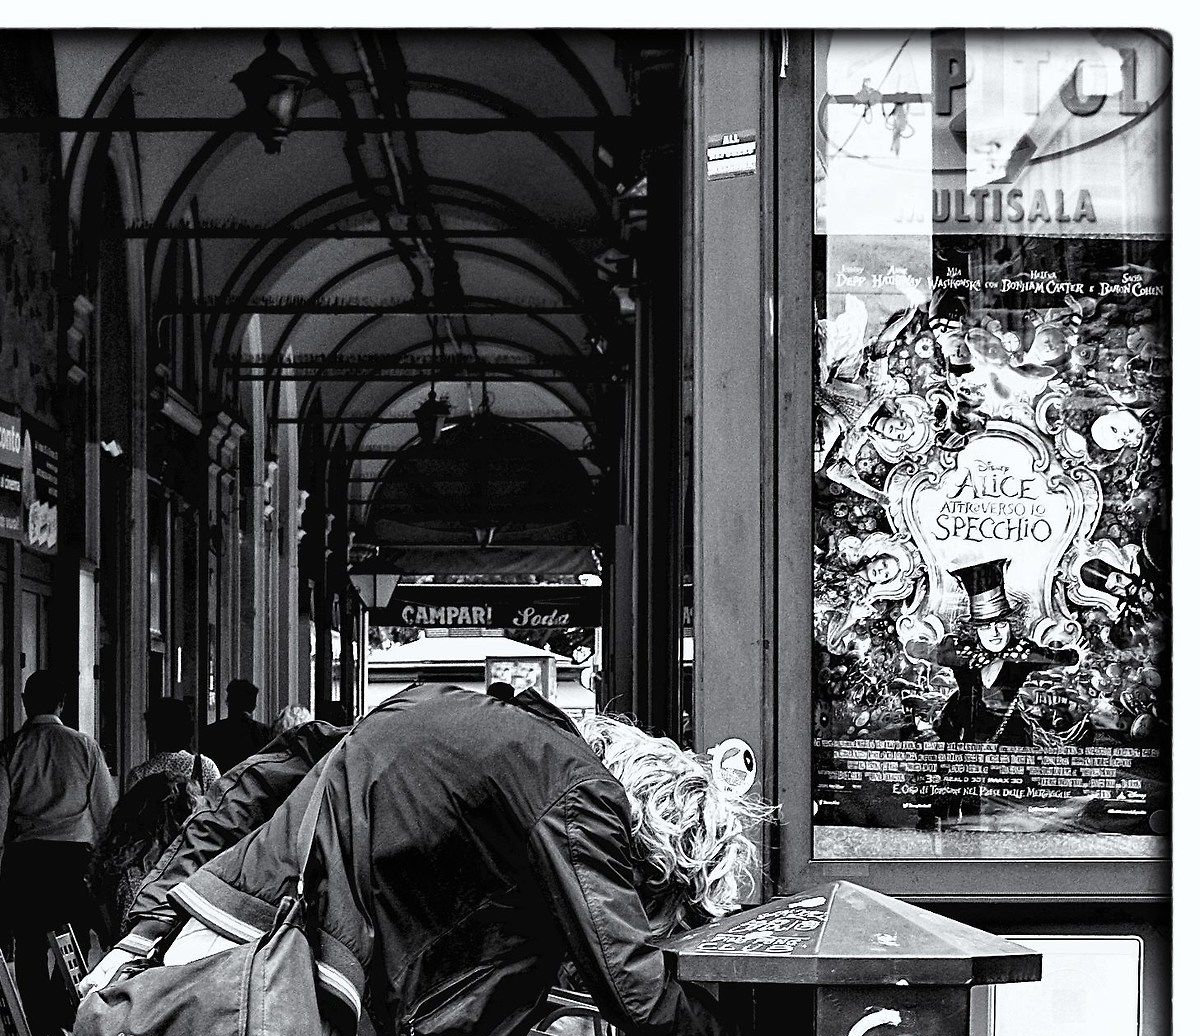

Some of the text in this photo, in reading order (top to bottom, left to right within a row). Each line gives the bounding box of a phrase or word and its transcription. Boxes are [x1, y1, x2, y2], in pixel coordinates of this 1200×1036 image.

[896, 188, 1097, 223] ULTISALA
[946, 467, 1039, 500] ALICE
[940, 501, 1026, 516] ATTRAVERSO
[931, 514, 1052, 542] SPECCHIO
[401, 604, 570, 626] CAMPARI Soda
